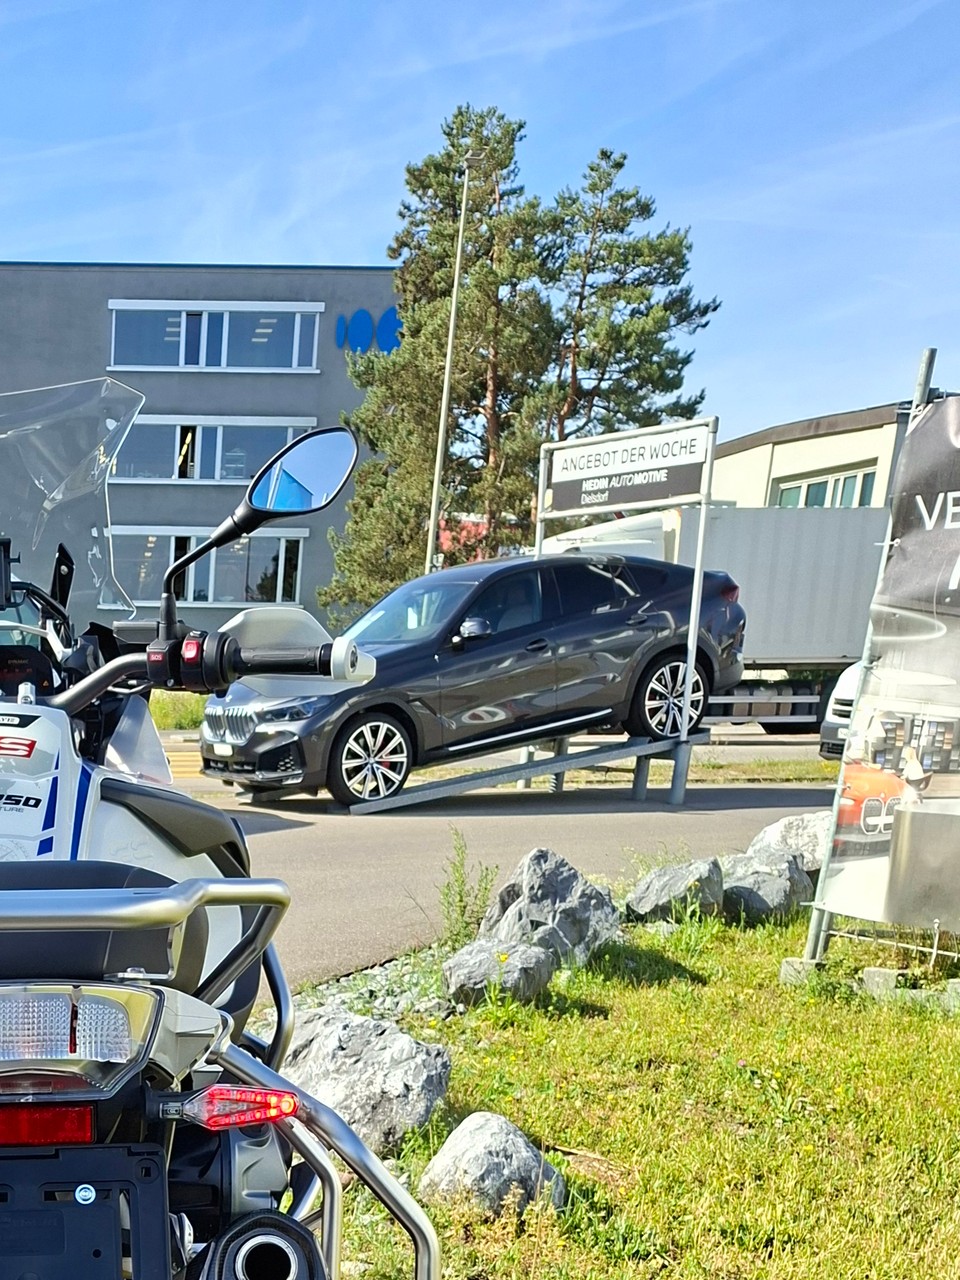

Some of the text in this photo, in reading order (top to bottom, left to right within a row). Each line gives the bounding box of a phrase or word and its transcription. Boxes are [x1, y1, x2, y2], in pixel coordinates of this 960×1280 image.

[561, 438, 698, 473] ANGEBOT DER WOCHE
[581, 469, 668, 492] HEDIN AUTOMOTIVE
[580, 490, 609, 505] Dielsdorf
